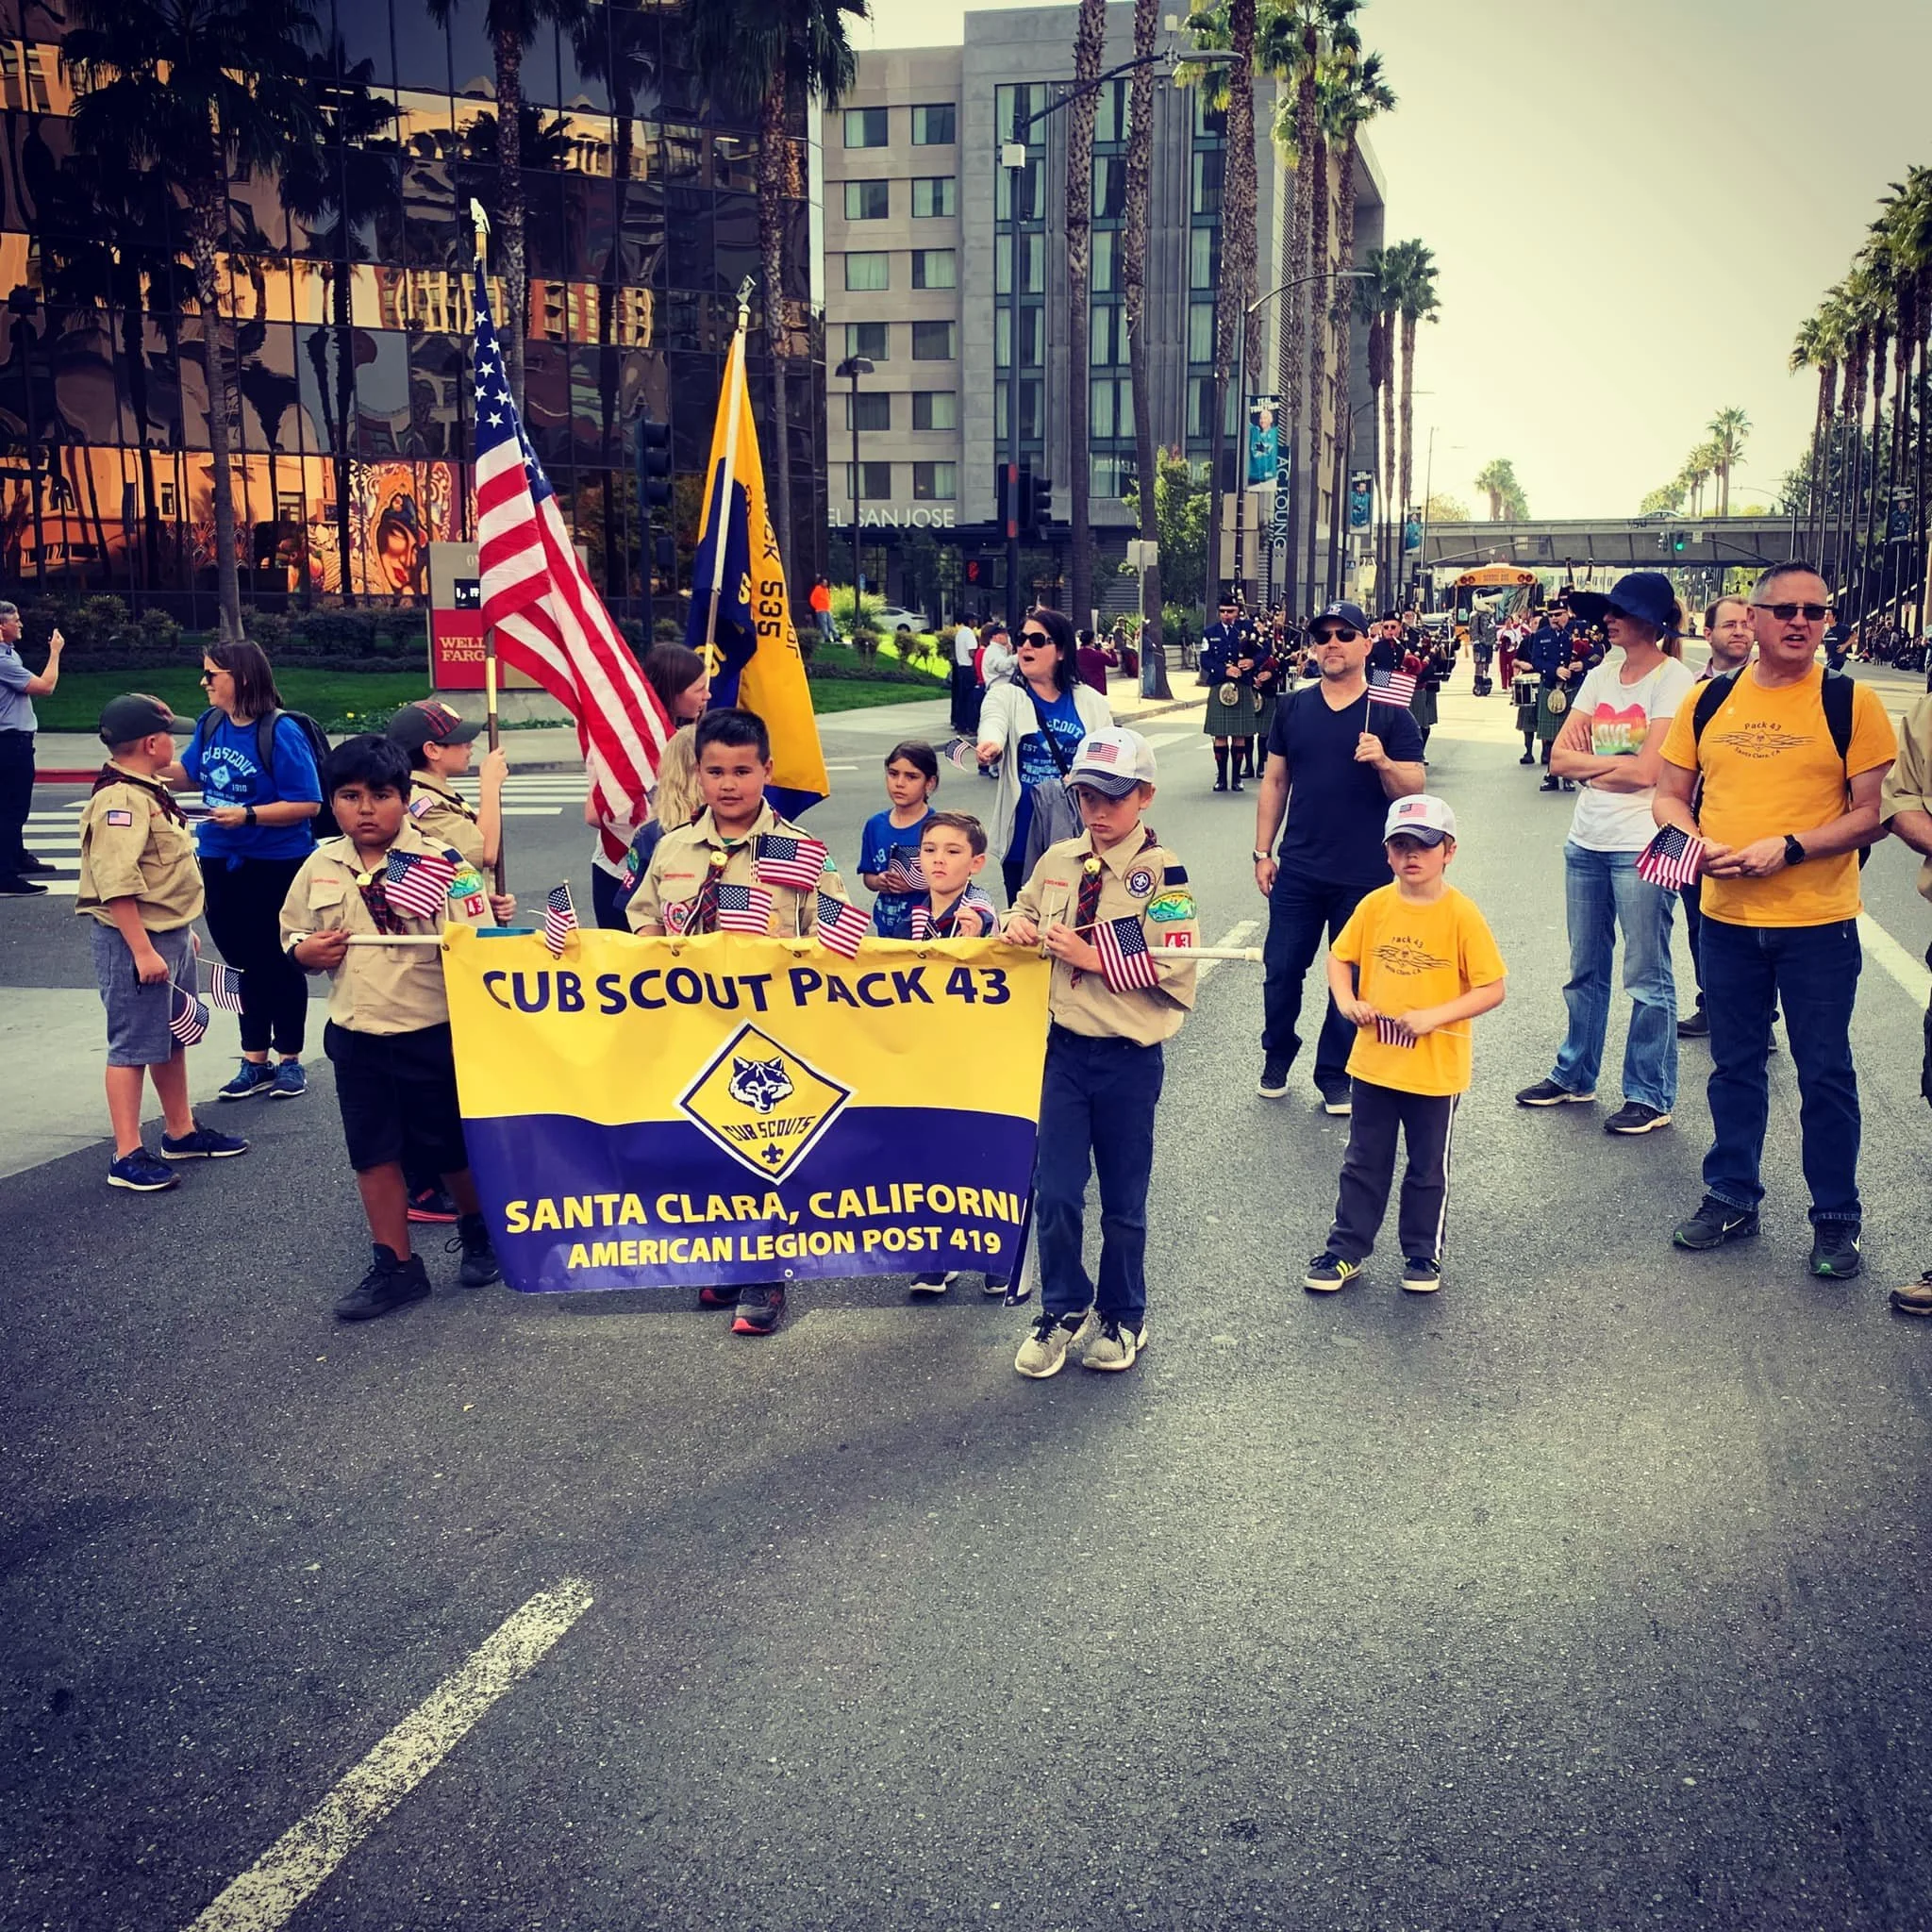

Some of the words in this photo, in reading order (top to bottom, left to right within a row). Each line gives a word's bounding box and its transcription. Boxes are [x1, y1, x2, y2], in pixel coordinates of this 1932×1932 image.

[1275, 456, 1290, 480] AC
[903, 508, 956, 528] JOSE
[758, 579, 784, 639] 535
[439, 636, 487, 649] WELL
[441, 649, 497, 662] FARG
[221, 746, 258, 777] SCOUT
[468, 895, 485, 914] 43
[1167, 933, 1190, 948] 43
[482, 970, 585, 1013] CUB
[595, 967, 773, 1014] SCOUT
[790, 966, 935, 1008] PACK
[945, 966, 1011, 1006] 43
[722, 1124, 758, 1141] CUB
[757, 1115, 817, 1139] SCOUTS
[505, 1192, 648, 1234] SANTA
[656, 1191, 800, 1225] CLARA,
[808, 1183, 1027, 1226] CALIFORNI
[567, 1236, 734, 1270] AMERICAN
[740, 1229, 856, 1261] LEGION
[862, 1225, 942, 1254] POST
[949, 1227, 1002, 1255] 419
